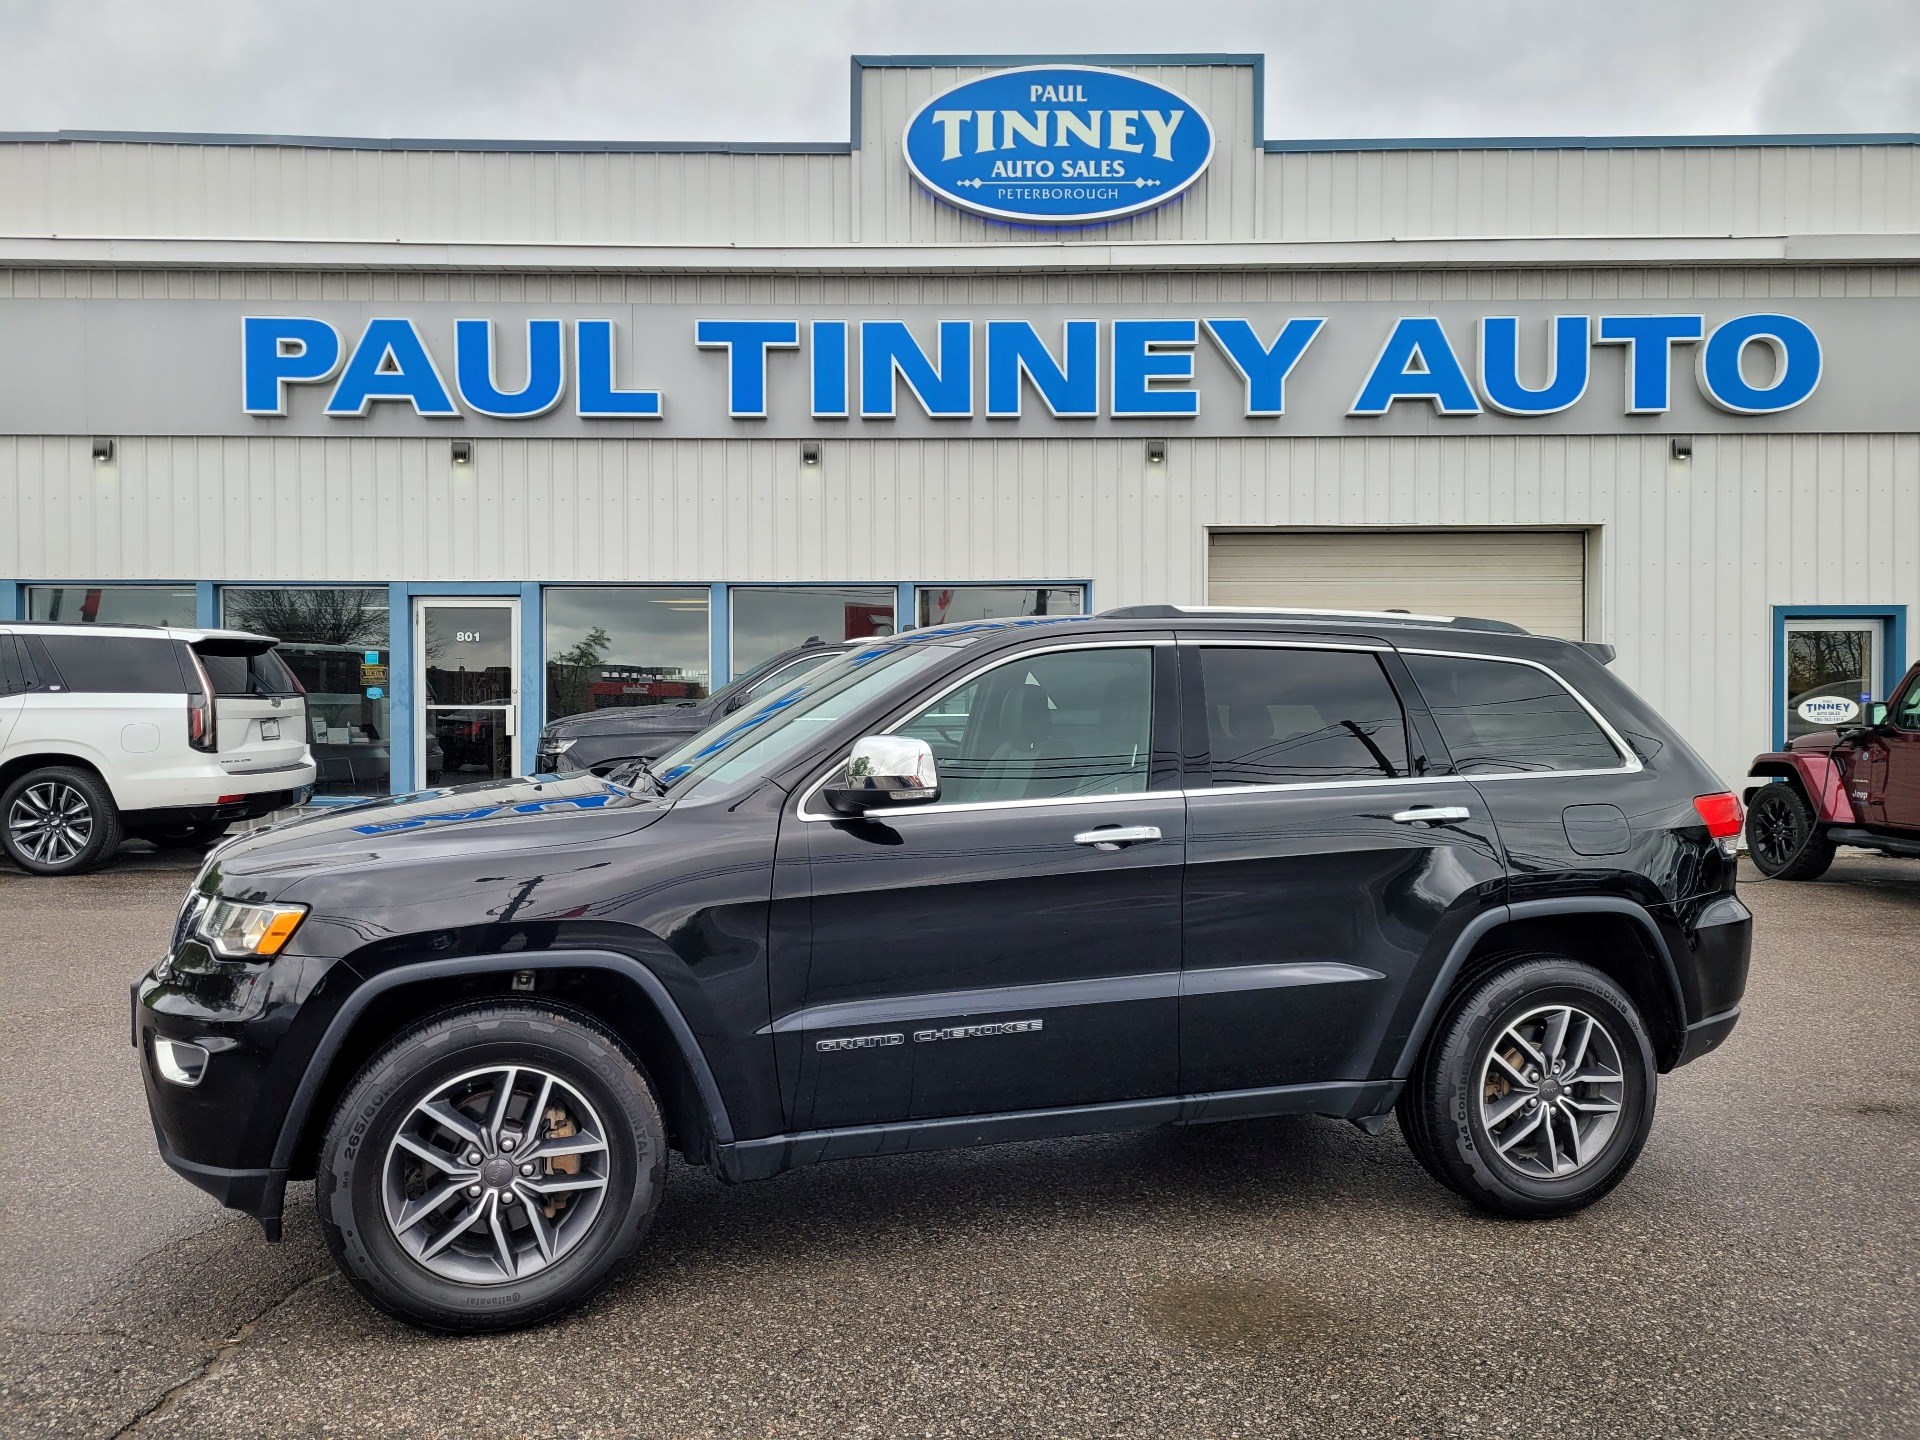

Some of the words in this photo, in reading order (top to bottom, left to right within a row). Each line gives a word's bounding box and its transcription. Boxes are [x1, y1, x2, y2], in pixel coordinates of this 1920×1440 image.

[1030, 85, 1088, 102] PAUL
[932, 110, 1185, 162] TINNEY
[991, 160, 1055, 178] AUTO
[1062, 160, 1125, 178] SALES
[998, 188, 1119, 200] PETERBOROUGH
[241, 315, 664, 418] PAUL
[694, 316, 1330, 418] TINNEY
[1345, 312, 1824, 416] AUTO
[456, 631, 480, 642] 801
[1806, 703, 1851, 713] TINNEY
[1852, 789, 1868, 800] Jeep
[816, 1033, 905, 1052] GRAND
[913, 1019, 1043, 1043] CHEROKEE
